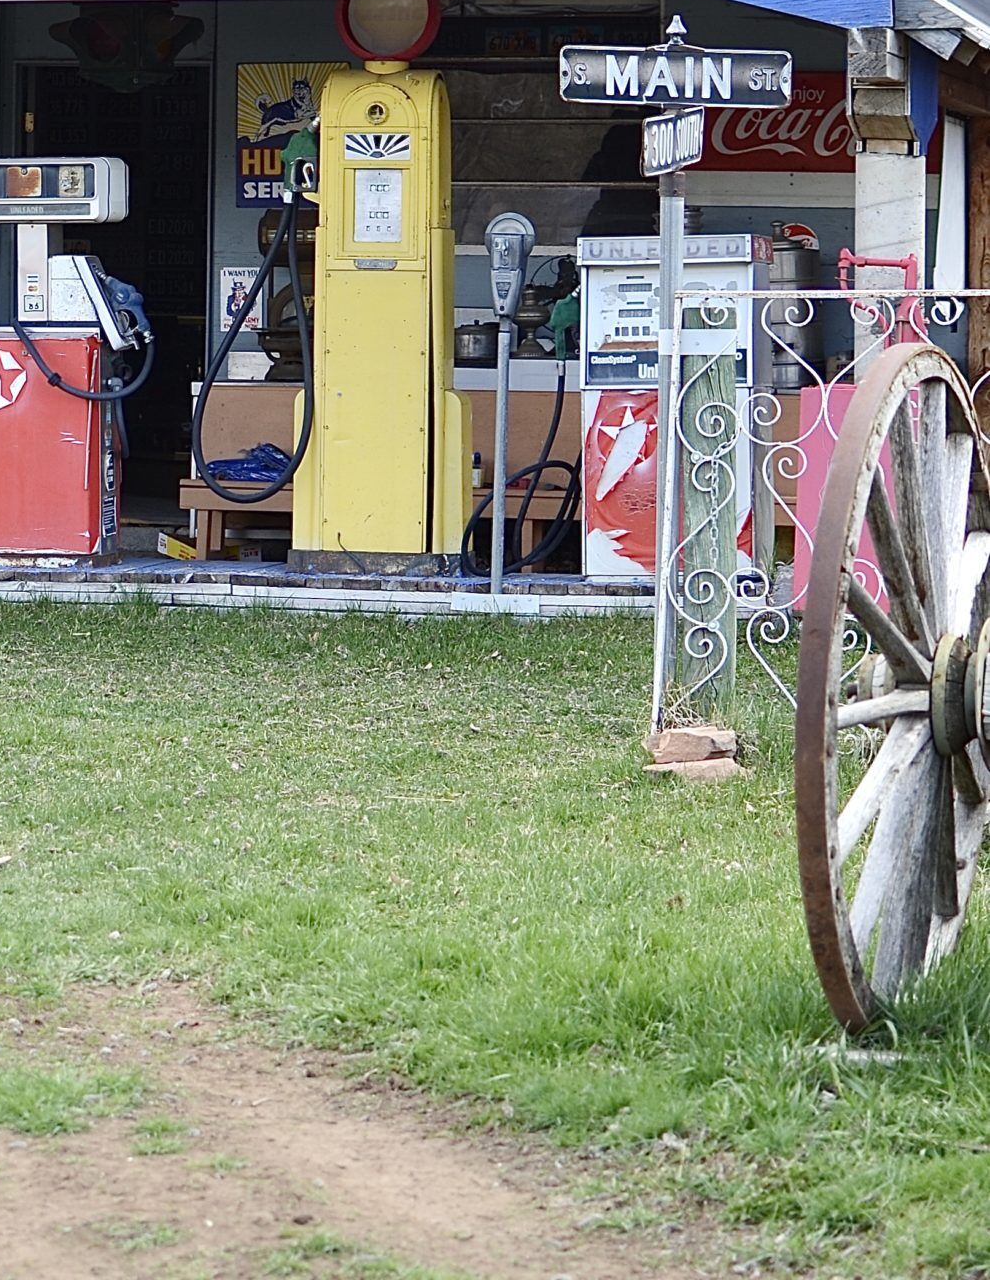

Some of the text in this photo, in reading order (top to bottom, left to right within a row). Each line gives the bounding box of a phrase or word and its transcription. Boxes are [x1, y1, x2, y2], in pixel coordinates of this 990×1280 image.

[573, 54, 778, 99] S. MAIN ST.
[792, 87, 825, 104] njoy
[651, 114, 700, 167] 300 SOUTH
[711, 98, 857, 157] Coca-C
[11, 206, 44, 215] UNLEADED
[589, 239, 740, 258] UNLEDED
